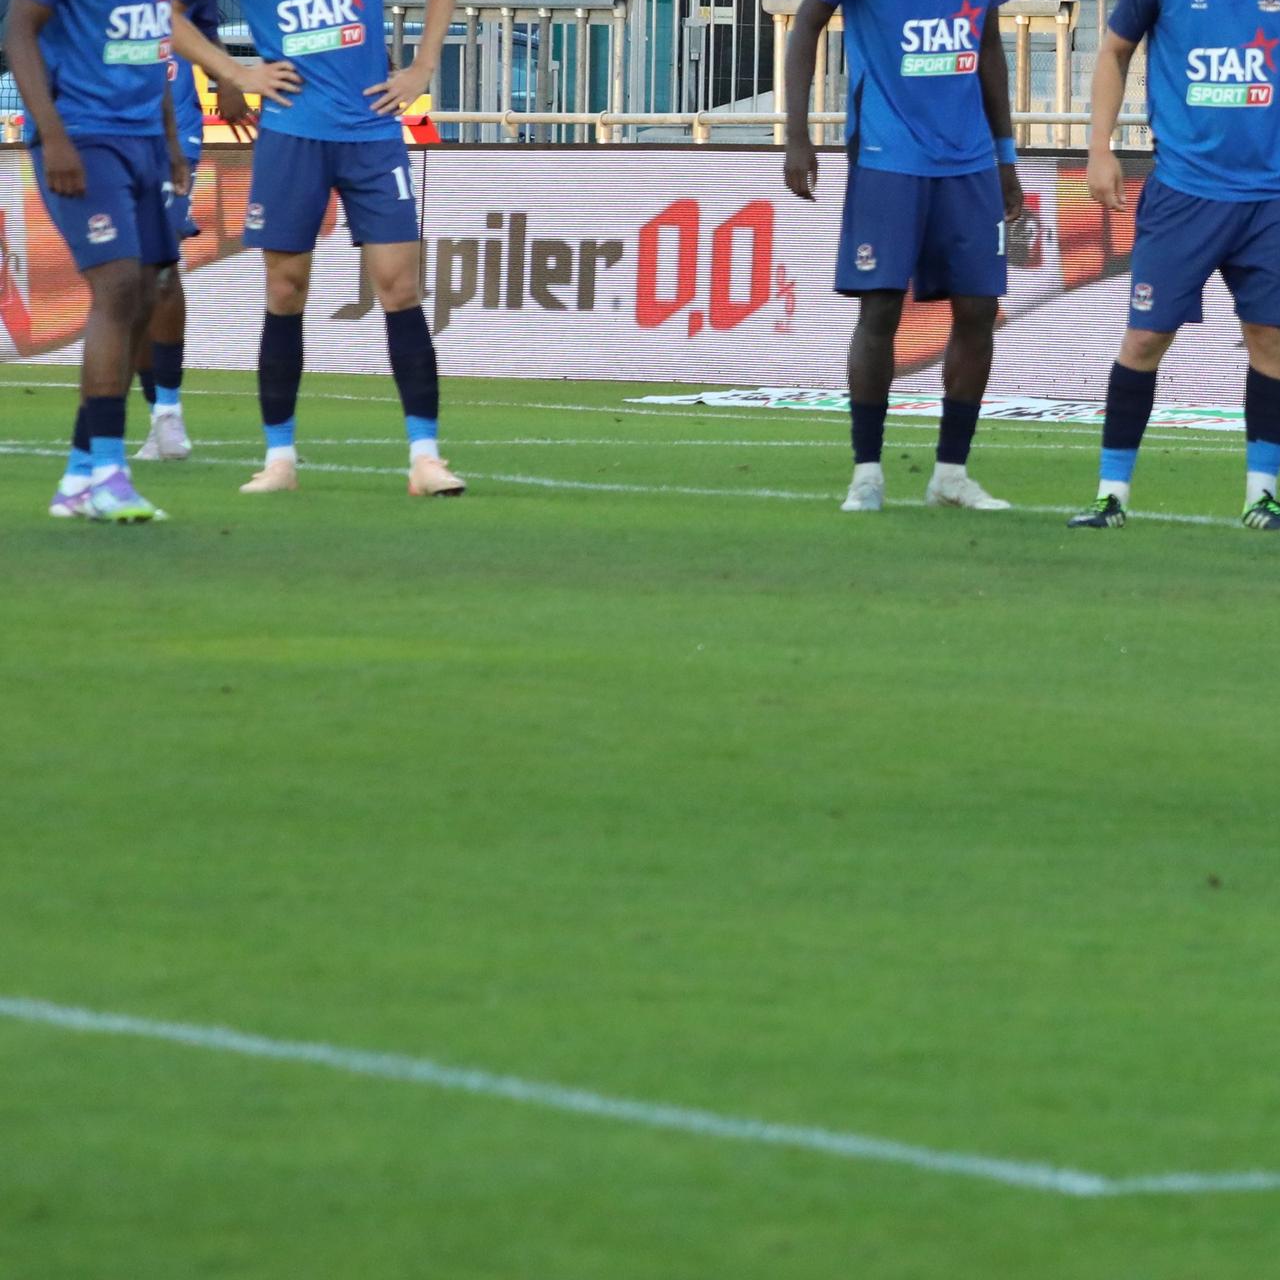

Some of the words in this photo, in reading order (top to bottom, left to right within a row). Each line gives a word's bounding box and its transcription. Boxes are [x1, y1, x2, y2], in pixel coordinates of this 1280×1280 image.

[286, 31, 338, 53] SPORT
[343, 27, 362, 42] TV
[900, 17, 973, 52] STAR
[903, 56, 954, 73] SPORT
[958, 56, 973, 69] TV
[1186, 46, 1269, 82] STAR
[1189, 86, 1245, 103] SPORT
[1249, 87, 1270, 102] TV
